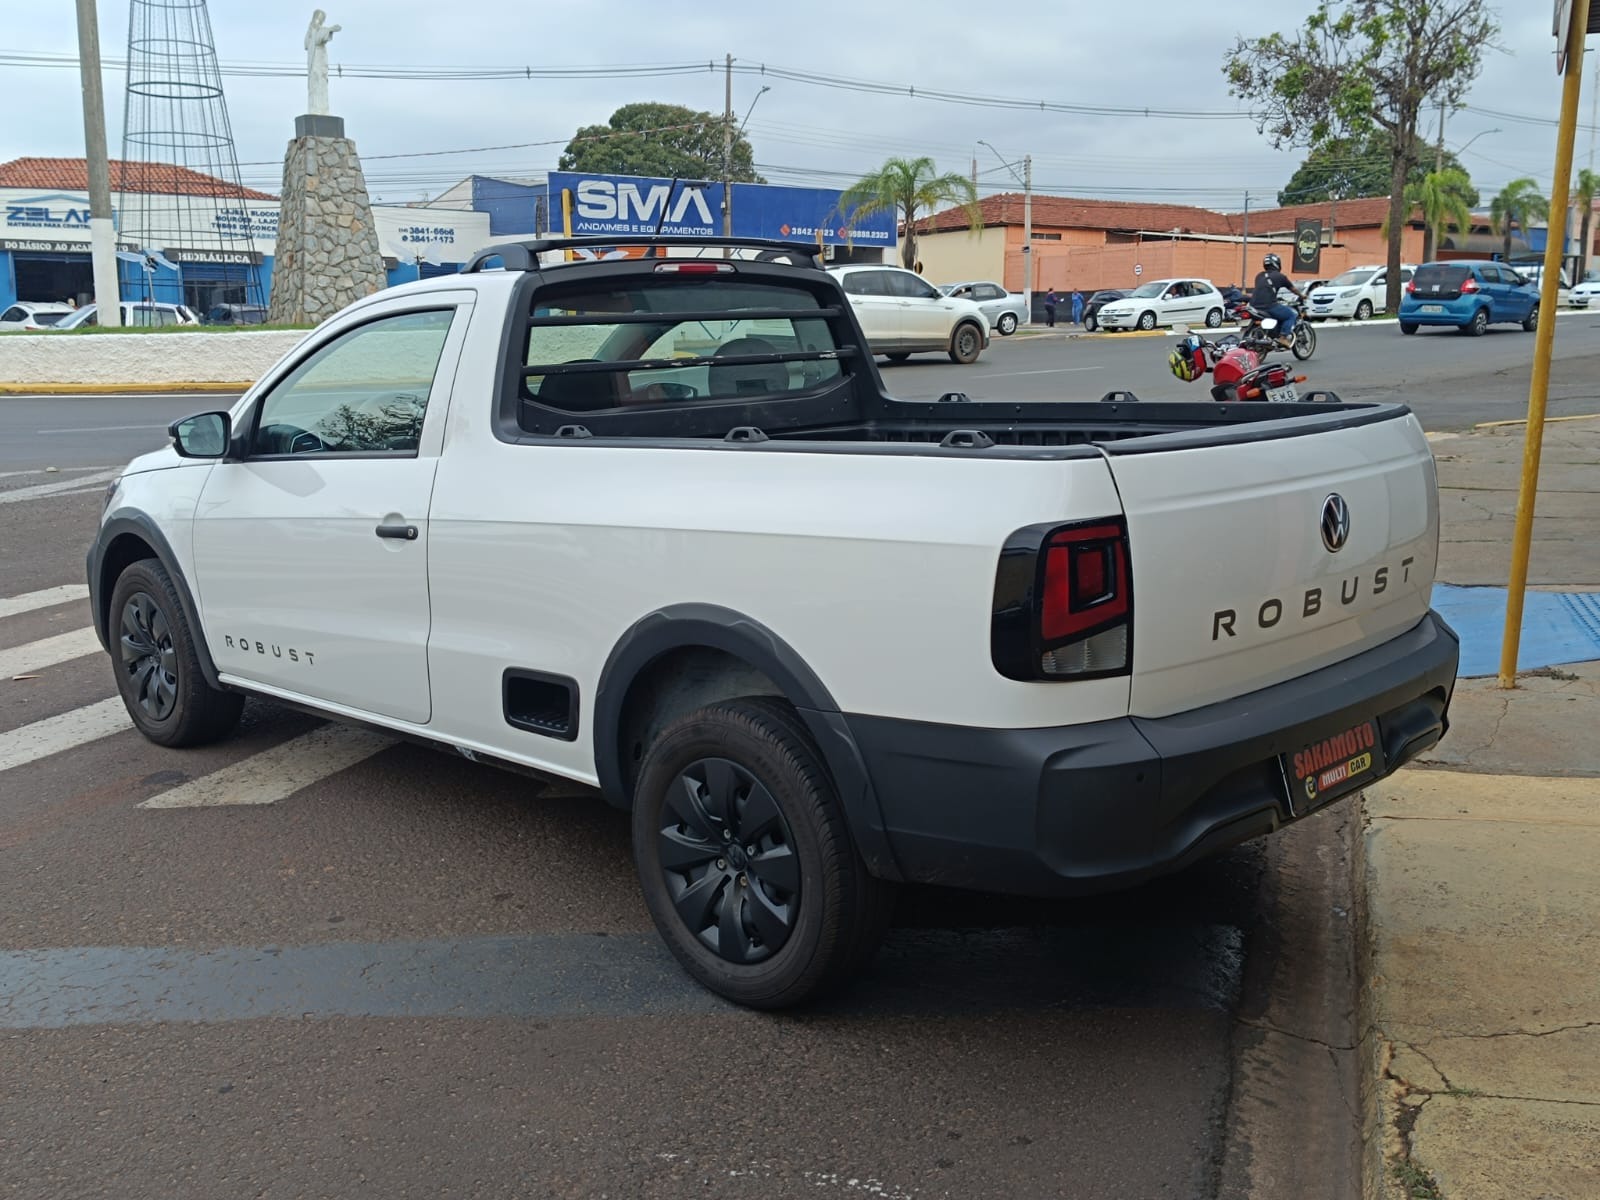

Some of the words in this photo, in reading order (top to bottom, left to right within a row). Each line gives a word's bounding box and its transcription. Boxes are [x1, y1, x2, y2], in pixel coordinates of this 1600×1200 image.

[250, 210, 280, 218] BLOCOS
[577, 180, 714, 224] SMA
[577, 222, 630, 232] ANDAIMES
[631, 224, 639, 233] E
[4, 241, 18, 249] DO
[19, 241, 52, 250] BÁSICO
[53, 243, 68, 251] AO
[1211, 556, 1415, 641] ROBUST
[224, 634, 314, 665] ROBUST
[1294, 722, 1375, 780] SAKAMOTO
[1321, 764, 1348, 788] MULTI
[1349, 757, 1367, 774] CAR
